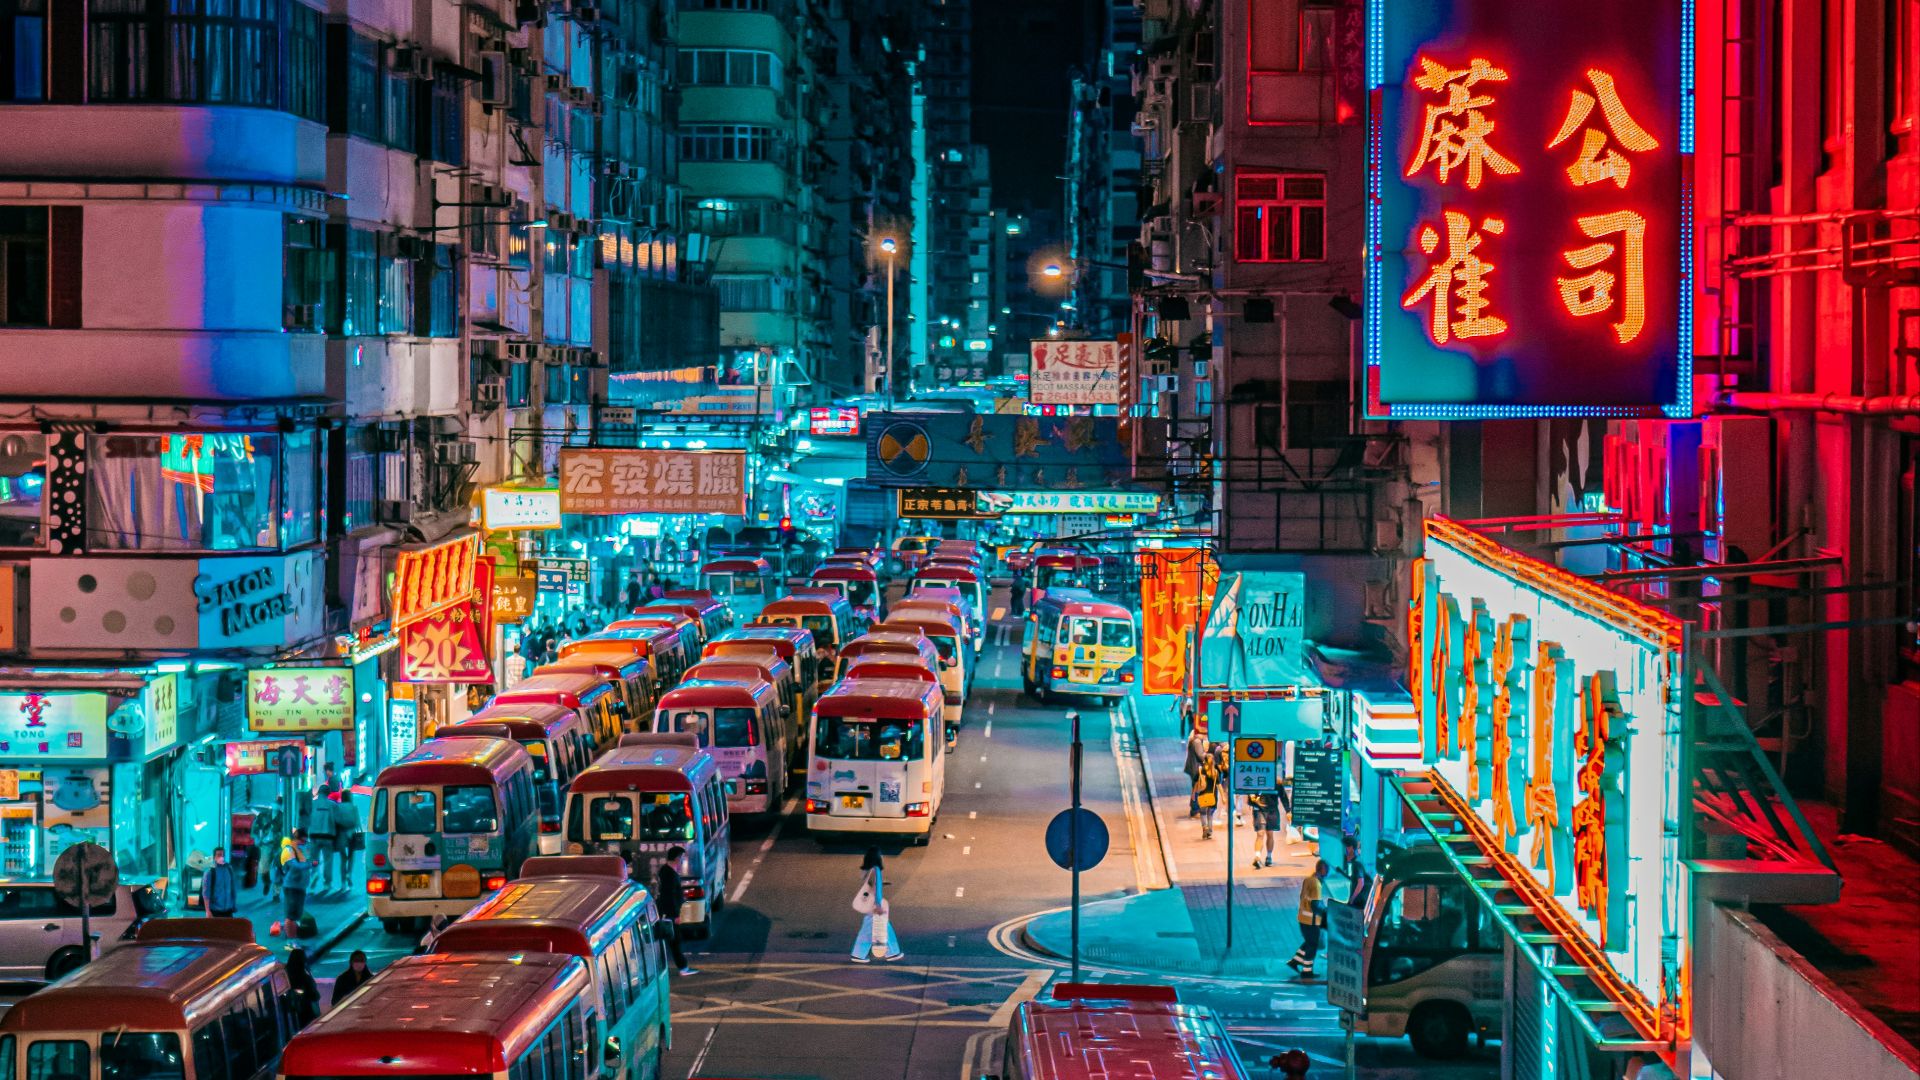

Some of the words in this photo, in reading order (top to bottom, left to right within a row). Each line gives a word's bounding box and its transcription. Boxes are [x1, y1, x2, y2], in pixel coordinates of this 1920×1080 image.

[1547, 68, 1659, 345] 公司
[565, 455, 739, 496] 宏發燒臘
[192, 567, 275, 613] SALON
[222, 594, 295, 636] MORE
[417, 637, 457, 668] 20
[1246, 637, 1286, 656] ALON
[254, 675, 350, 705] 海天堂
[316, 708, 342, 716] TONG
[14, 730, 46, 738] TONG
[1240, 765, 1252, 773] 24
[1255, 765, 1270, 773] hrs
[1242, 775, 1266, 786] 全日
